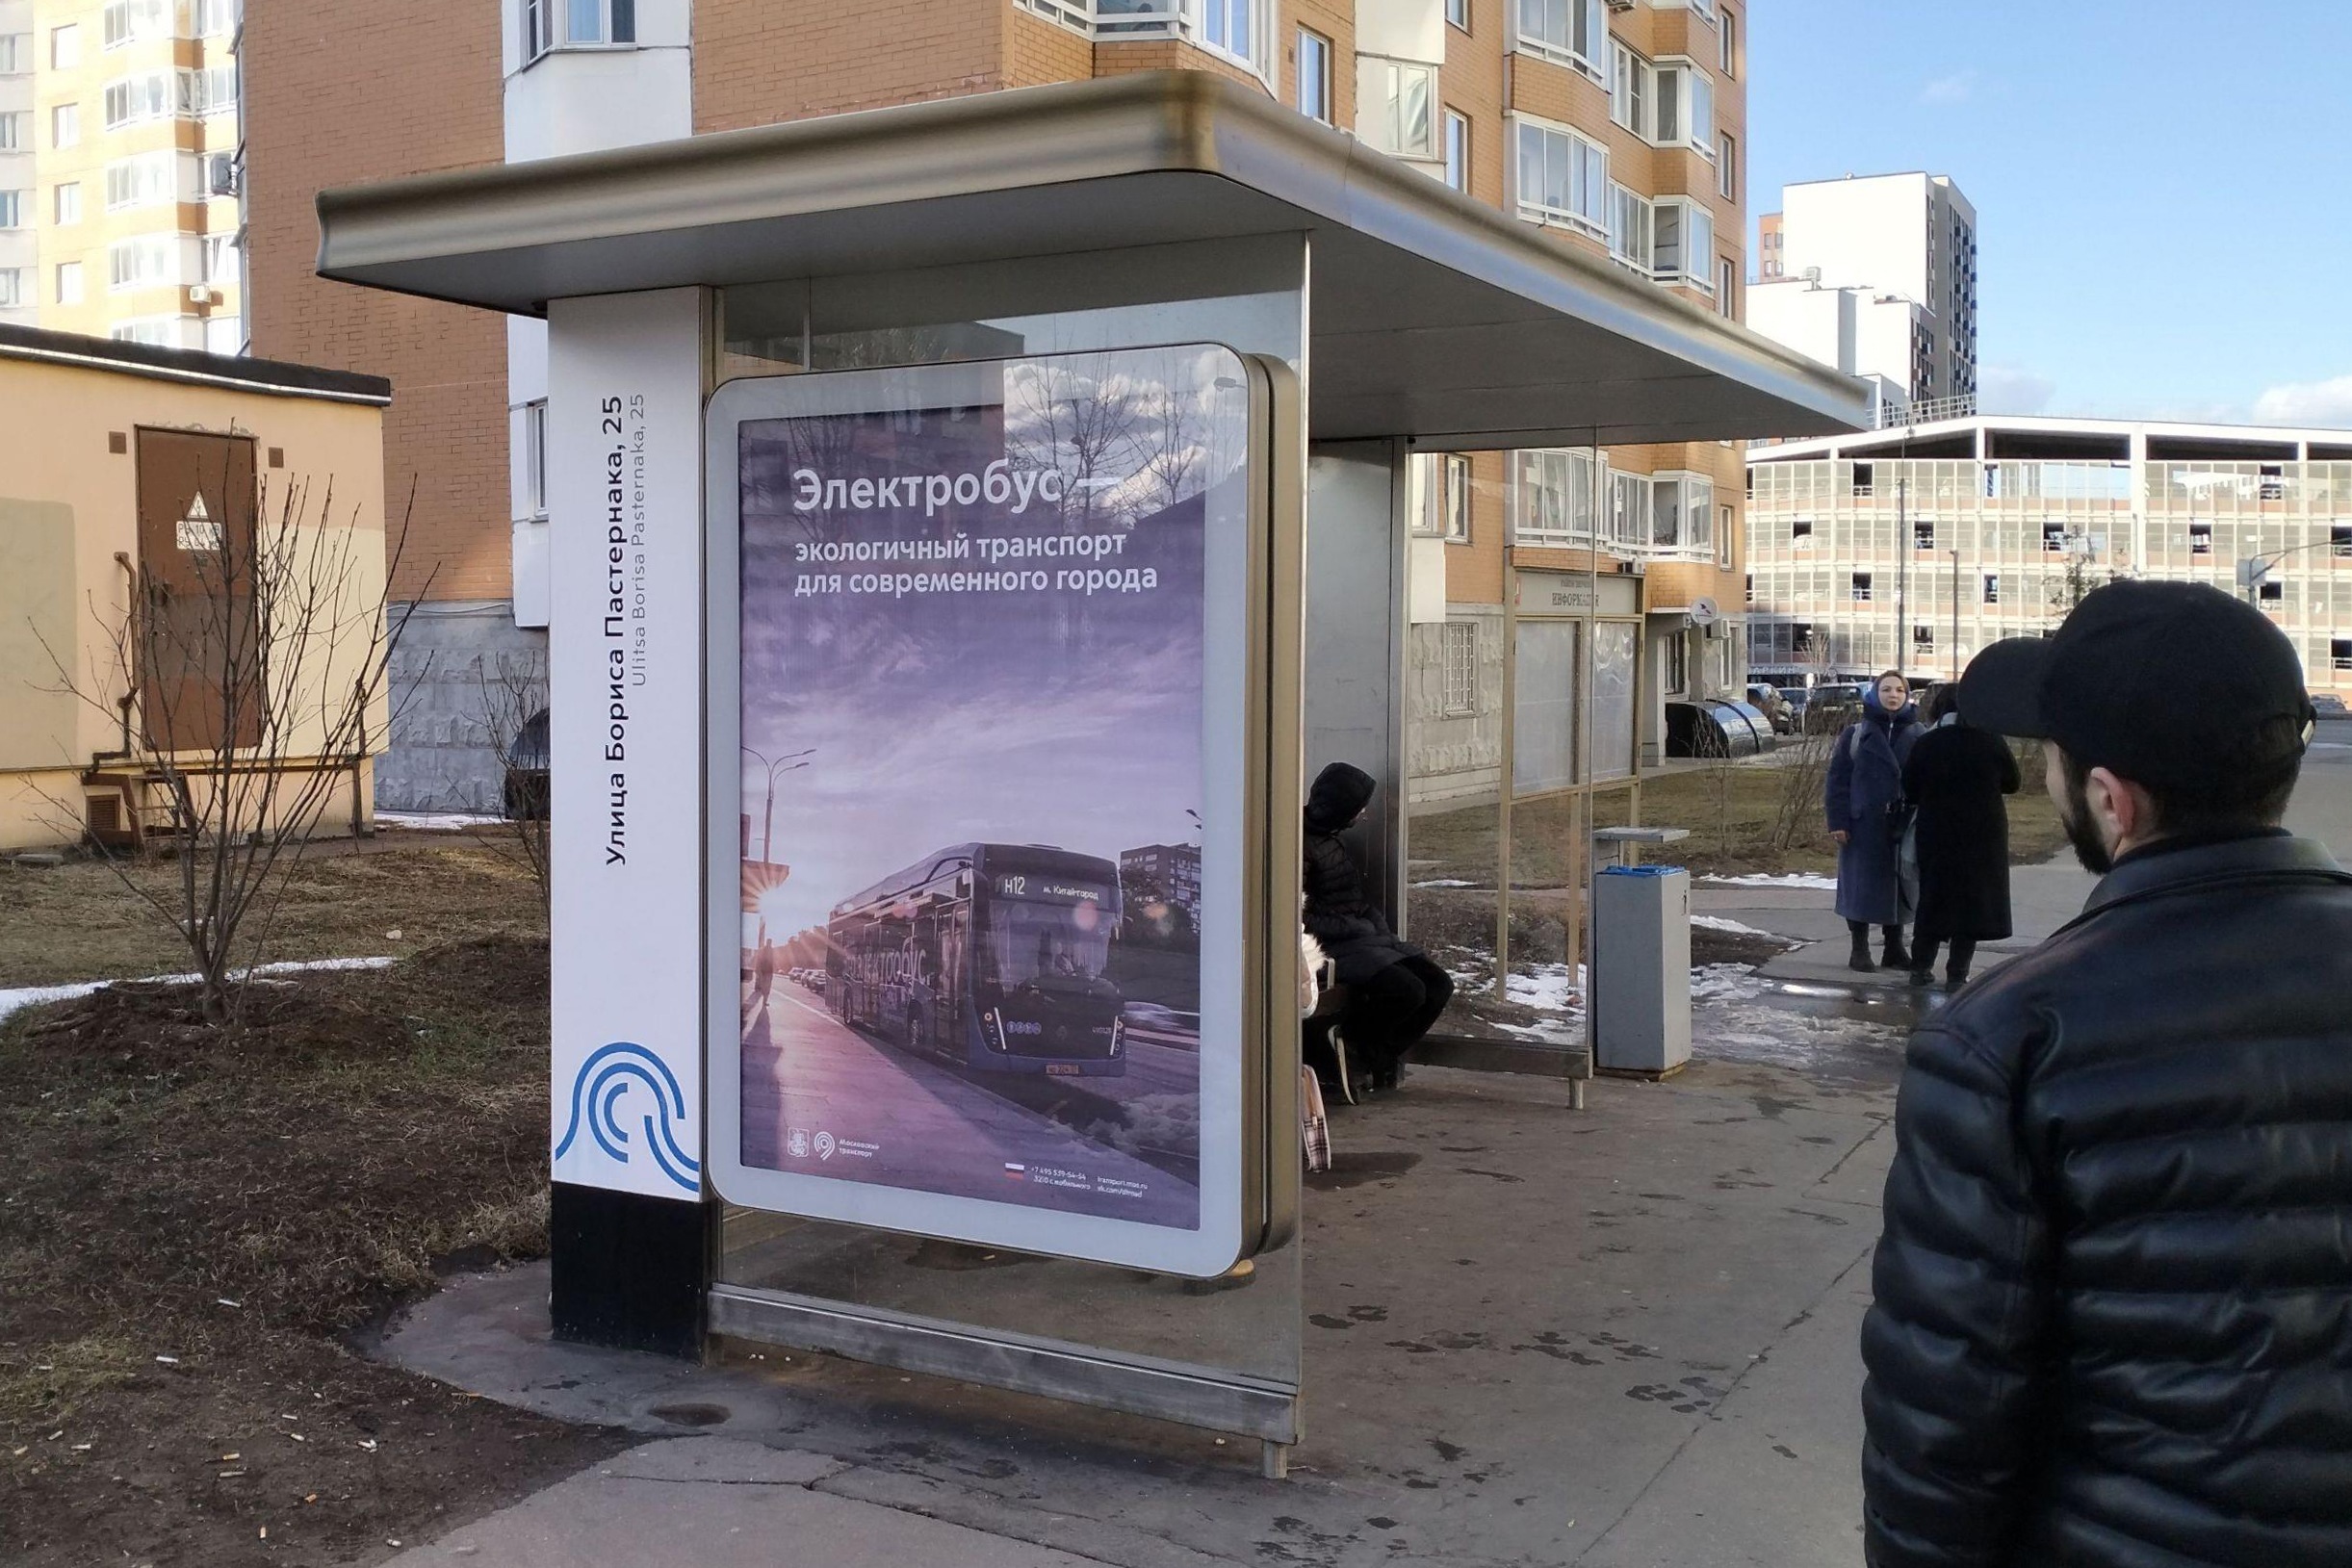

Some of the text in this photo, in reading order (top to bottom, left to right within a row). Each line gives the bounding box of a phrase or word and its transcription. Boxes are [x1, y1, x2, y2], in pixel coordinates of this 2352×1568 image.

[792, 459, 1062, 516] Электробус
[630, 394, 647, 687] Ulitsa Borisa Pasternaka, 25
[795, 533, 1126, 562] экологичный транспорт
[794, 565, 1157, 599] для современного города
[1552, 593, 1600, 607] ИНФОРМАЦЯ
[602, 396, 629, 866] Улица Бориса Пастернака, 25
[839, 1138, 880, 1150] Московский
